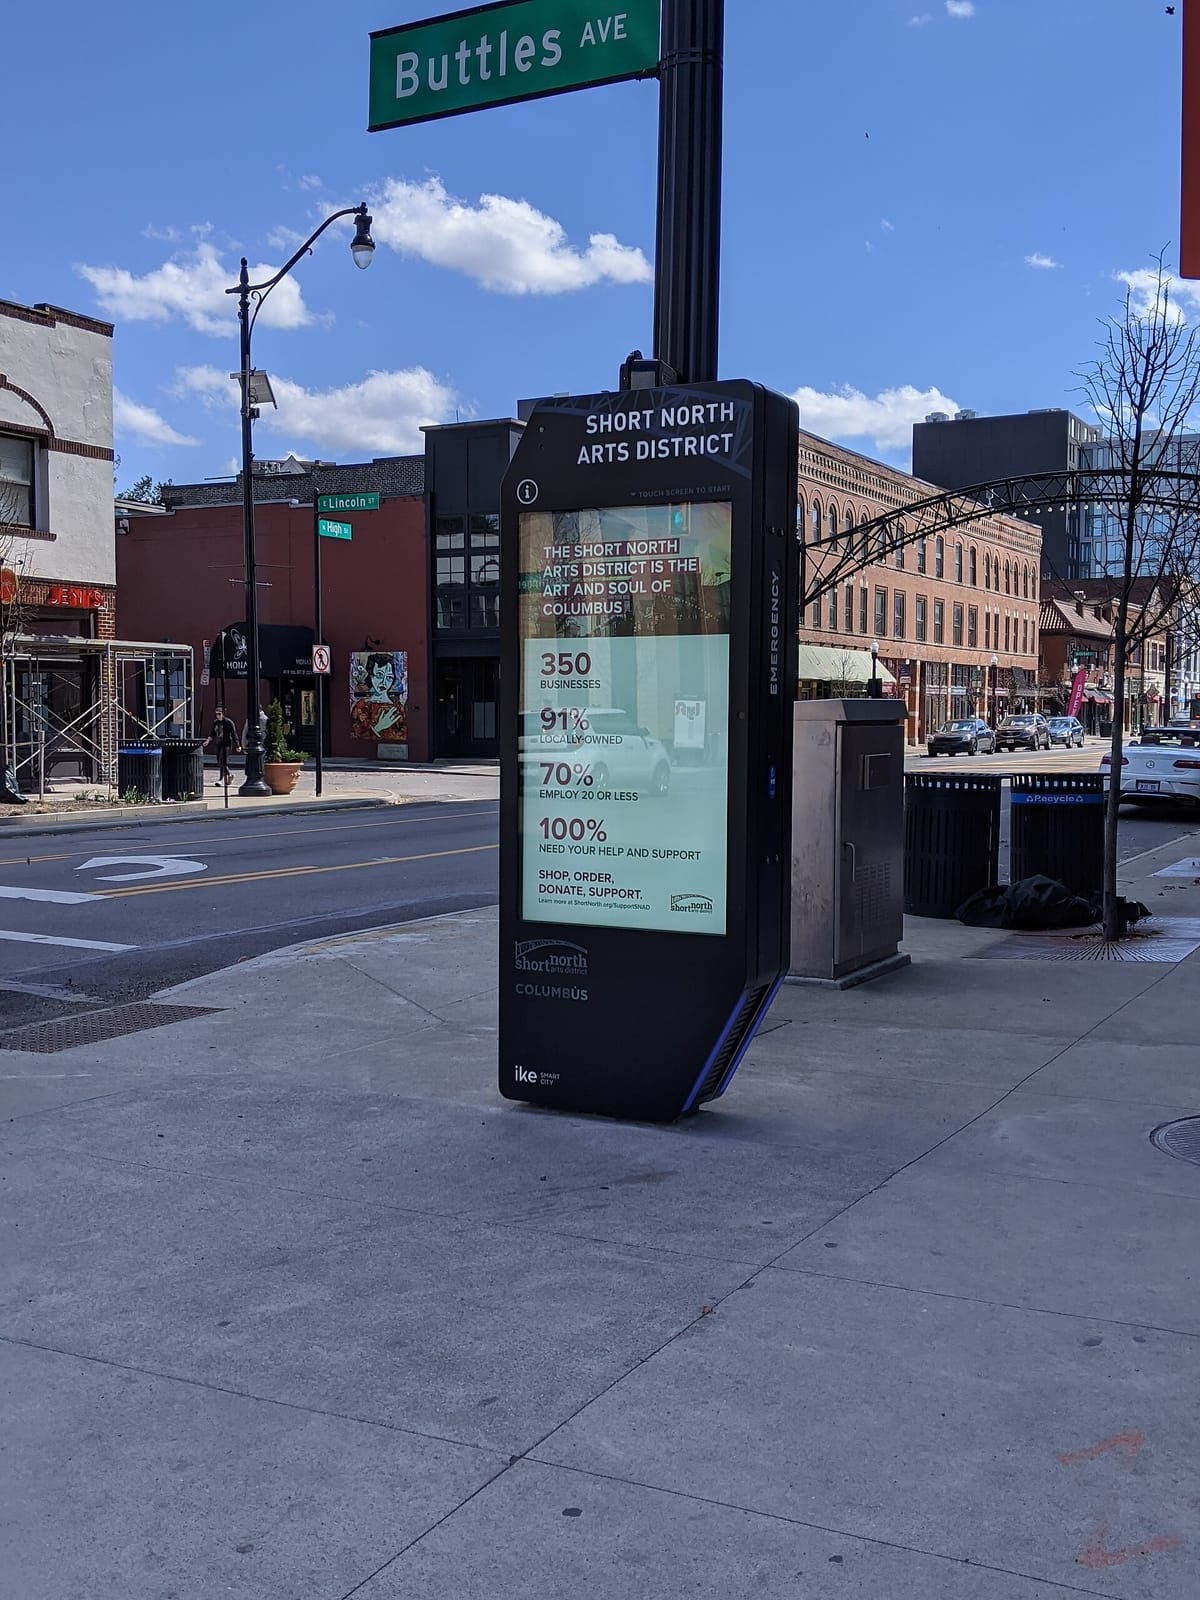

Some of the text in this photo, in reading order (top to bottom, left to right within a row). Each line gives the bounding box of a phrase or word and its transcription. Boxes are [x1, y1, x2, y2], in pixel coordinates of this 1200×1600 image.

[396, 13, 627, 99] Buttles AVE
[586, 401, 734, 434] SHORT NORTH
[577, 433, 733, 465] ARTS DISTRICT
[639, 489, 664, 498] TOUCH
[666, 487, 694, 496] SCREEN
[708, 484, 731, 493] START
[329, 497, 366, 508] Lincoln
[326, 521, 343, 537] High
[543, 539, 678, 559] THE SHORT NORTH
[543, 558, 697, 578] ARTS DISTRICT IS THE
[543, 583, 570, 597] ART
[573, 582, 605, 596] AND
[608, 580, 647, 595] SOUL
[651, 579, 672, 593] OF
[543, 601, 623, 616] COLUMBUS
[770, 571, 779, 695] EMERGENCY
[540, 652, 592, 676] 350
[540, 680, 601, 689] BUSINESSES
[540, 707, 590, 731] 91%
[539, 734, 623, 745] LOCALLY-OWNED
[539, 762, 594, 786] 70%
[539, 789, 639, 801] EMPLOY 20 OR LESS
[1034, 795, 1075, 803] Recycle
[539, 817, 608, 842] 100%
[539, 844, 701, 861] NEED YOUR HELP AND SUPPORT
[539, 869, 615, 884] SHOP, ORDER,
[539, 884, 643, 900] DONATE, SUPPORT.
[574, 900, 650, 910] ShortNorth.org/SupportSNAD
[671, 903, 690, 912] short
[690, 901, 712, 910] north
[515, 954, 588, 972] short north
[551, 966, 588, 976] arts district
[515, 983, 588, 1001] COLUMBUS
[515, 1065, 537, 1083] ike
[540, 1072, 560, 1080] SMART
[540, 1078, 554, 1086] CITY
